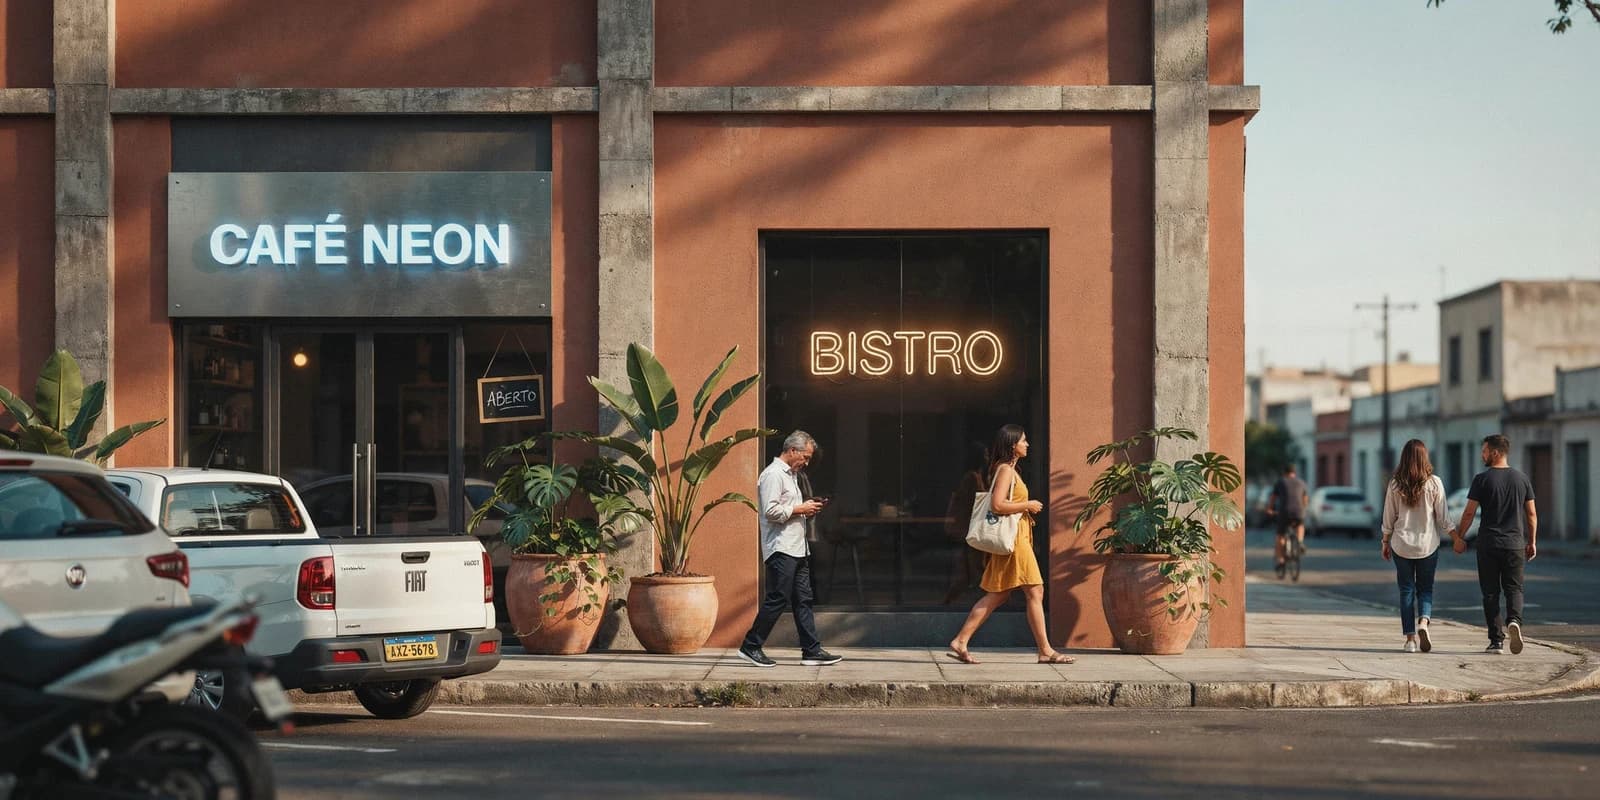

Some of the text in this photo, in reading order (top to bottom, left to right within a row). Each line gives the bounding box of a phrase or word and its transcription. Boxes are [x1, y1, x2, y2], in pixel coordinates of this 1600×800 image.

[210, 213, 509, 266] CAFÉ NEON
[810, 330, 1003, 376] BISTRO
[487, 390, 537, 407] ABERTO
[405, 570, 427, 592] FIAT
